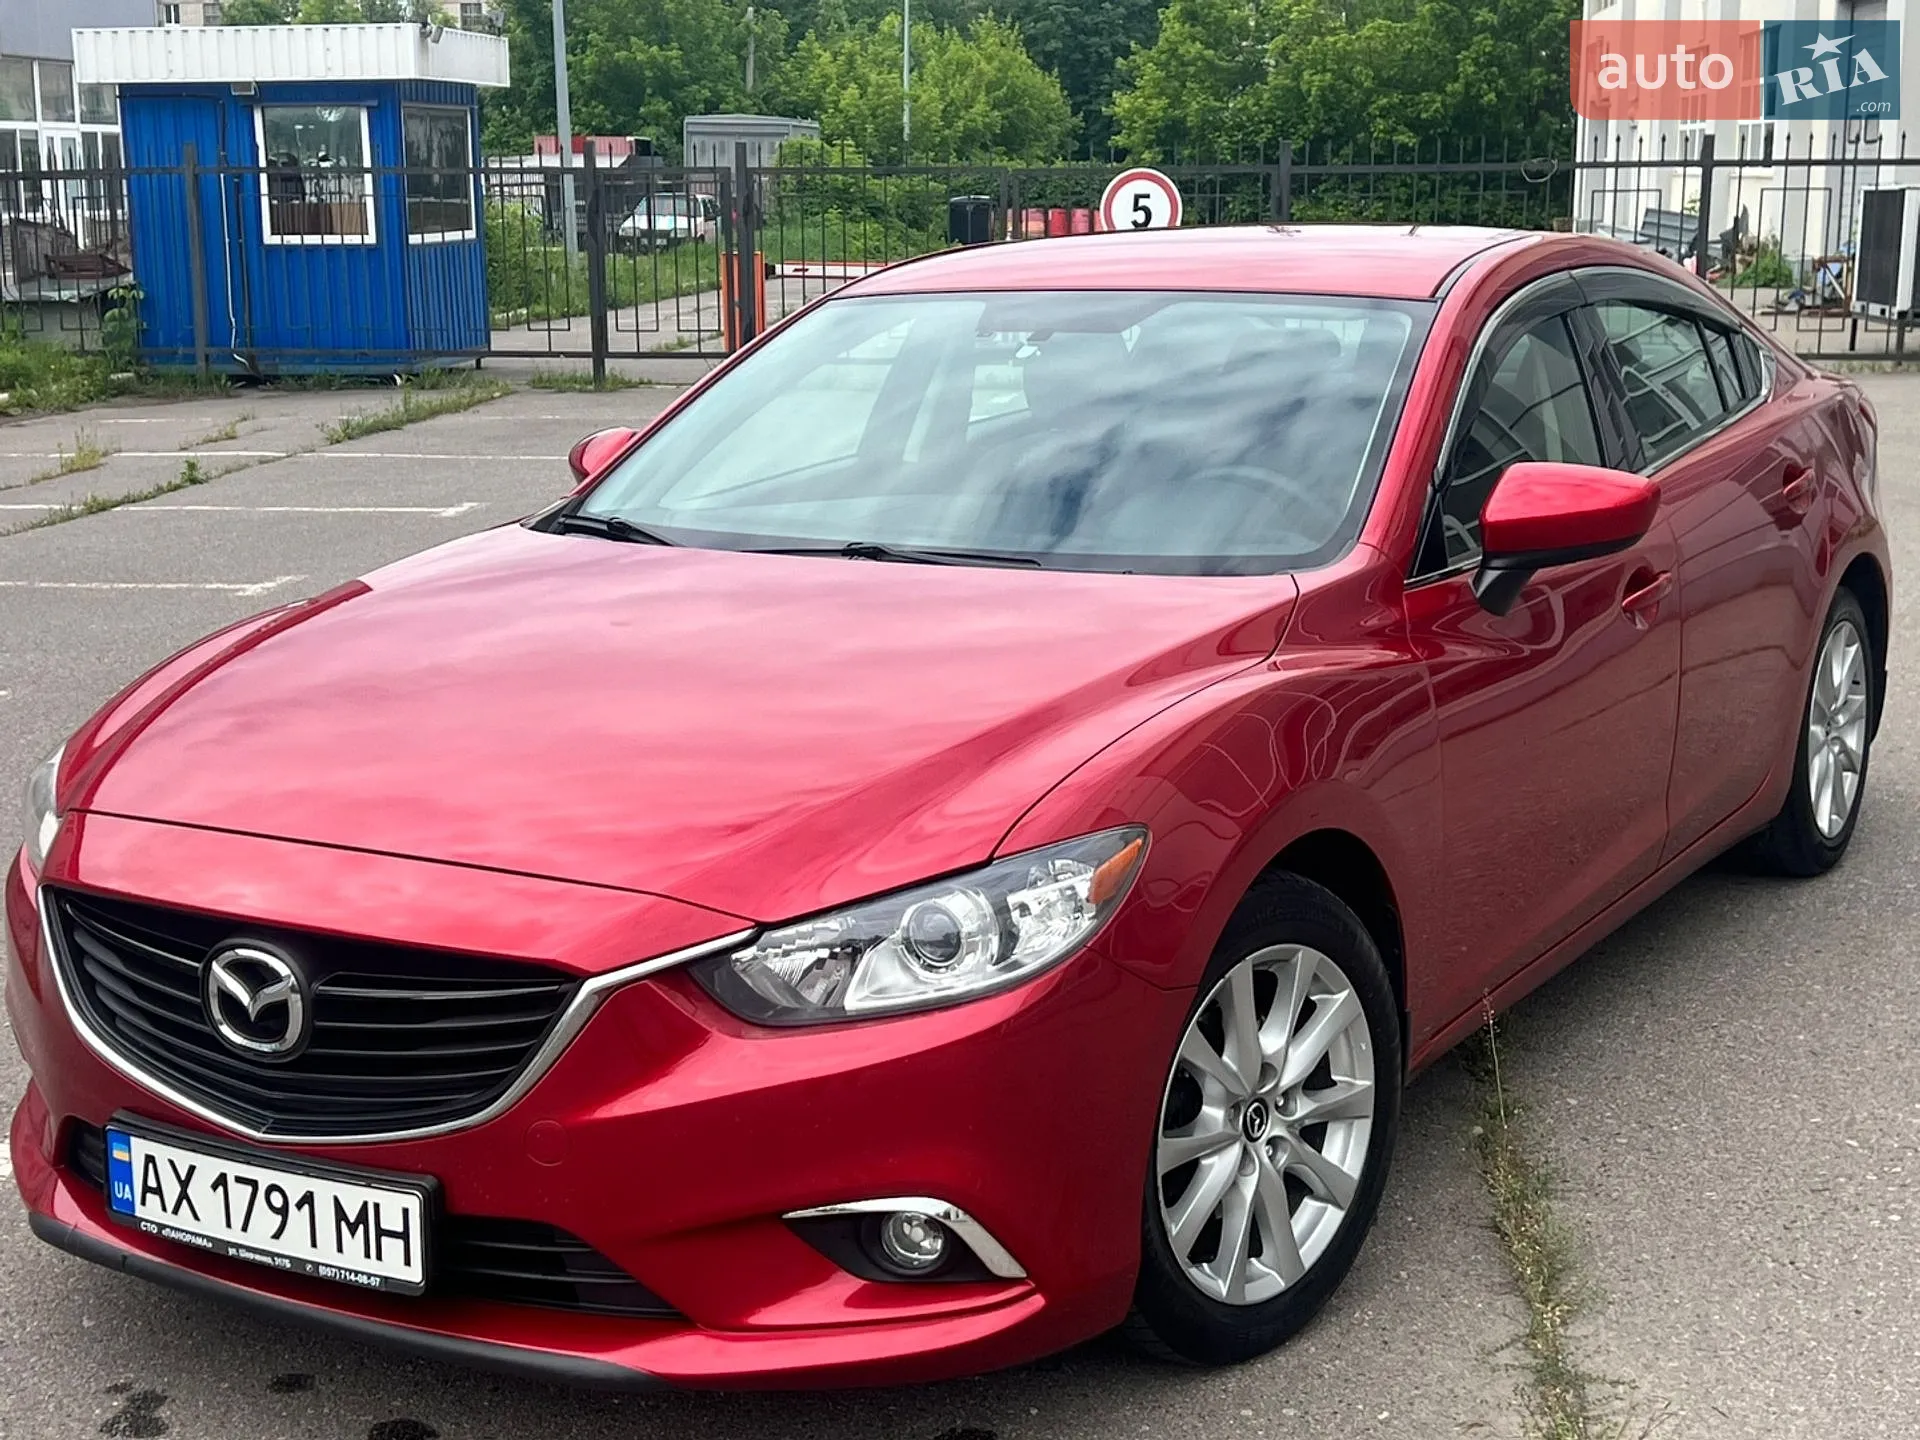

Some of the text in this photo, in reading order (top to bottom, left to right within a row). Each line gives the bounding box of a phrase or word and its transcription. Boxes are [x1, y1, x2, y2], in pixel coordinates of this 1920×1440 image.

[1131, 193, 1152, 228] 5
[114, 1181, 132, 1200] UA
[140, 1153, 411, 1267] AX 1791 MH
